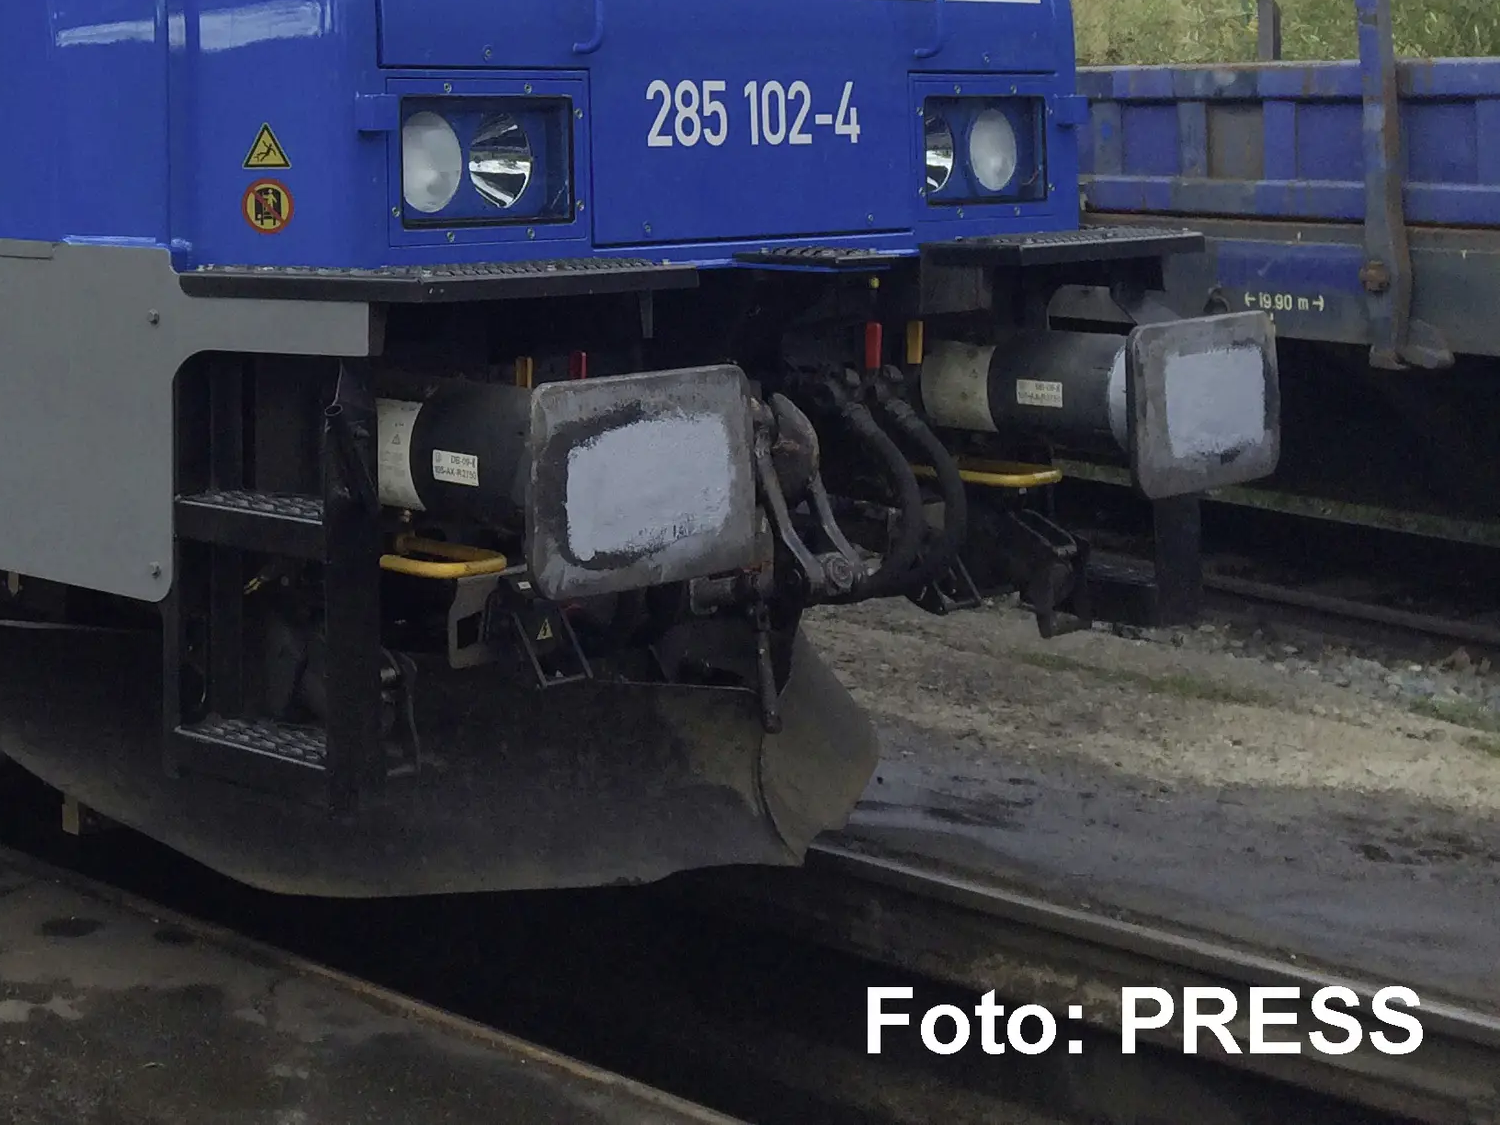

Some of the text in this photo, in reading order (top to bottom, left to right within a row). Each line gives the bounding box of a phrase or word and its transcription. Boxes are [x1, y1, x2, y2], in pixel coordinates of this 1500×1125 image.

[645, 79, 861, 147] 285 102-4
[1259, 291, 1309, 311] 19.90 m
